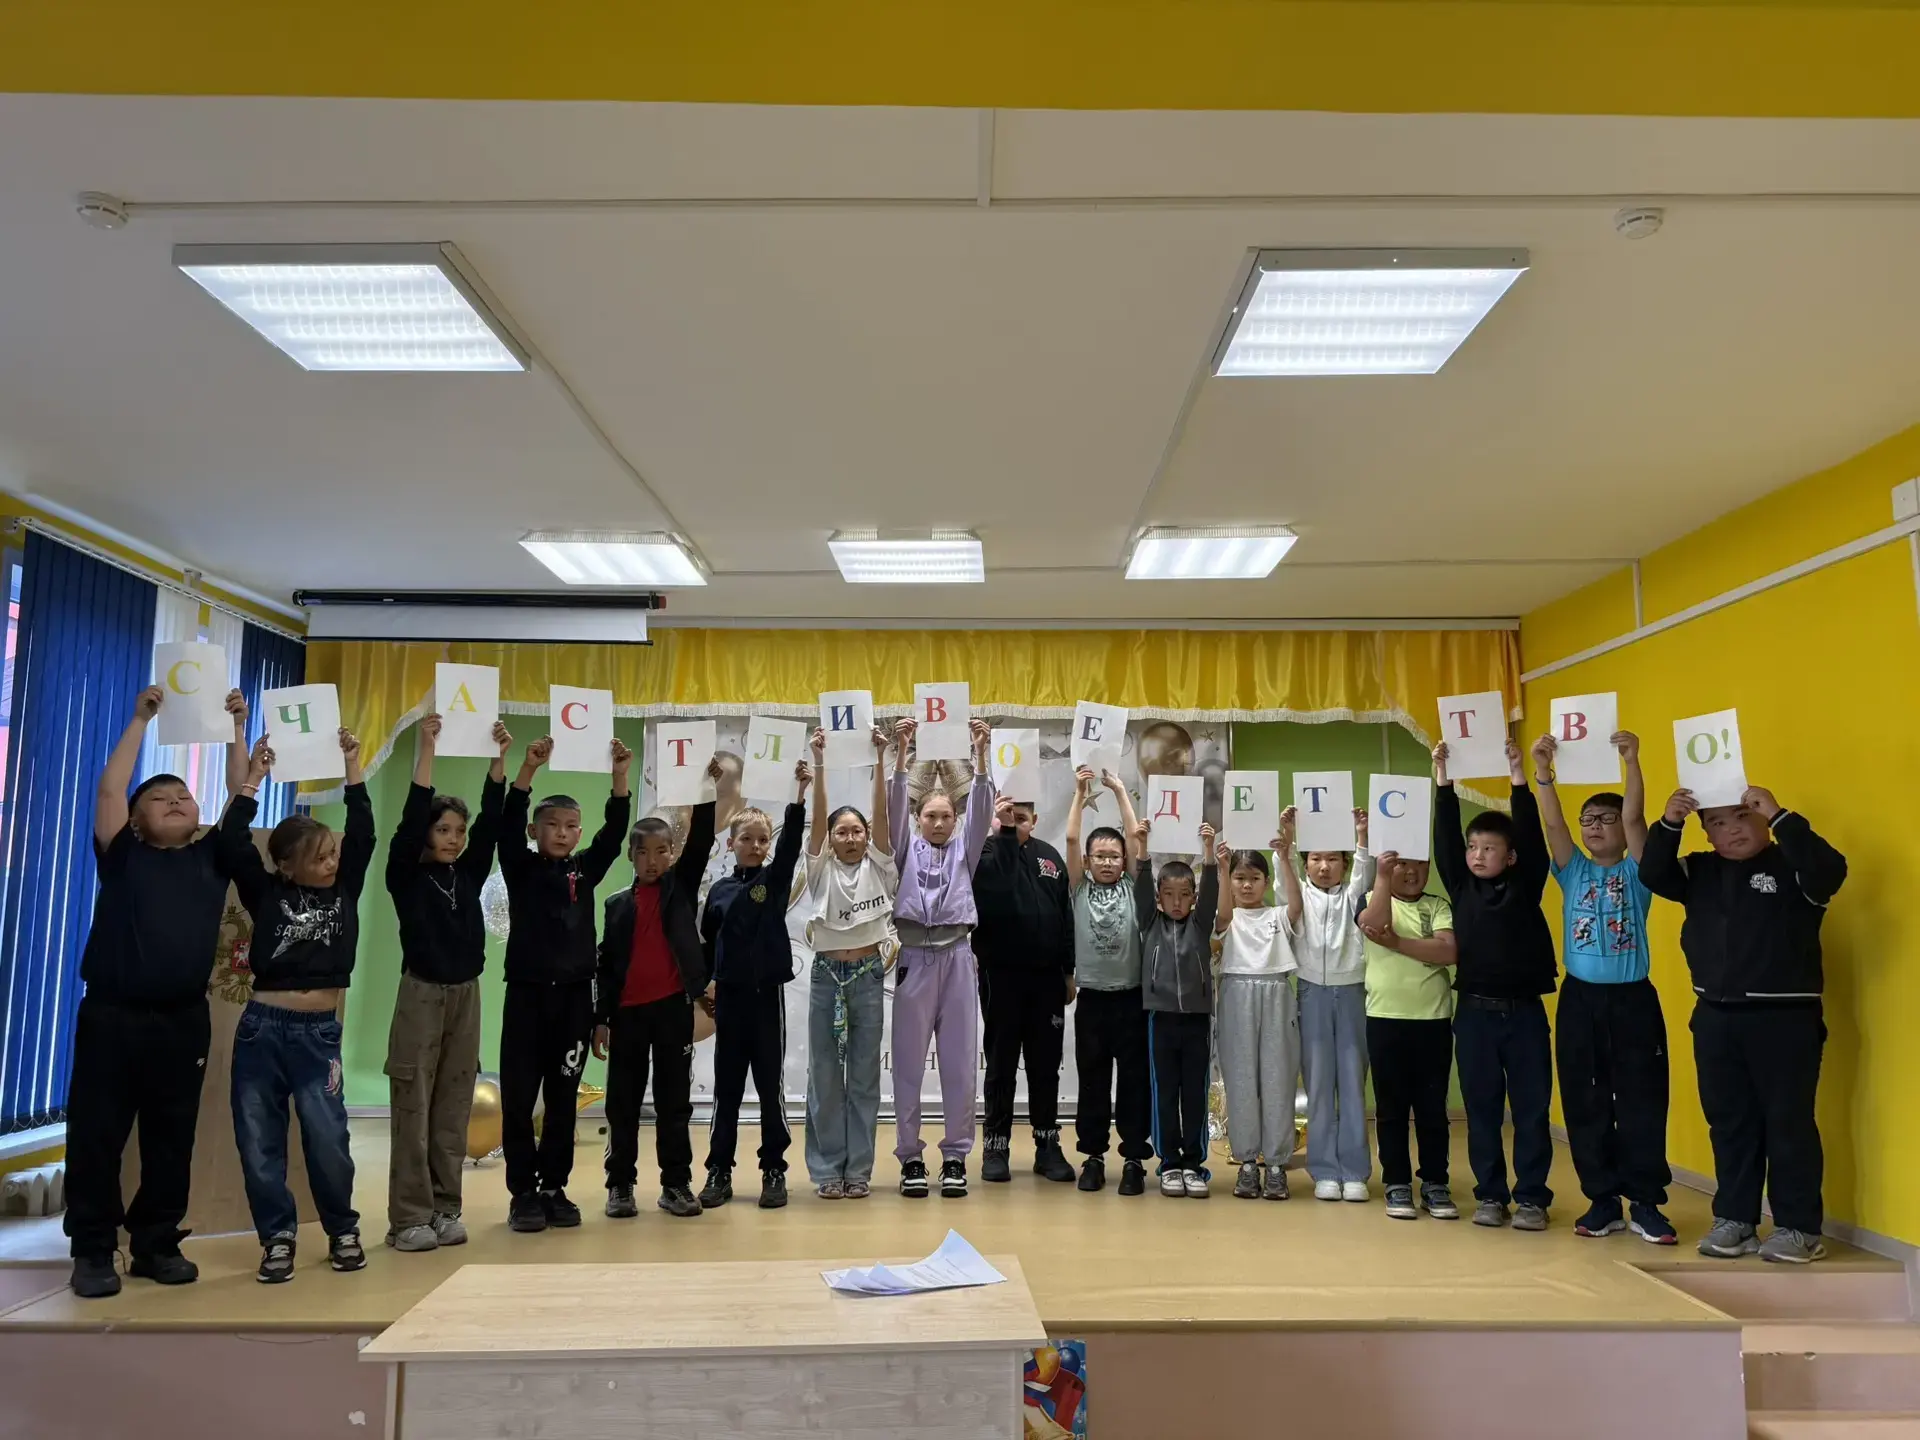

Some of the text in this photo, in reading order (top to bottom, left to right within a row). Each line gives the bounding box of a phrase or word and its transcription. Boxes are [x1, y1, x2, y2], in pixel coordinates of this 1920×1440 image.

[167, 661, 203, 695] С
[448, 682, 478, 713] А
[923, 697, 947, 723] В
[276, 702, 313, 734] Ч
[560, 702, 589, 731] С
[830, 704, 857, 732] И
[1080, 715, 1103, 742] Е
[1448, 709, 1476, 739] Т
[1559, 712, 1588, 742] В
[667, 738, 694, 767] Т
[753, 733, 783, 763] Л
[997, 744, 1022, 768] О
[1687, 728, 1732, 765] О!
[1154, 789, 1181, 823] Д
[1231, 785, 1255, 812] Е
[1302, 786, 1328, 813] Т
[1378, 790, 1407, 819] С
[851, 900, 871, 913] GOT
[872, 894, 885, 908] IT!
